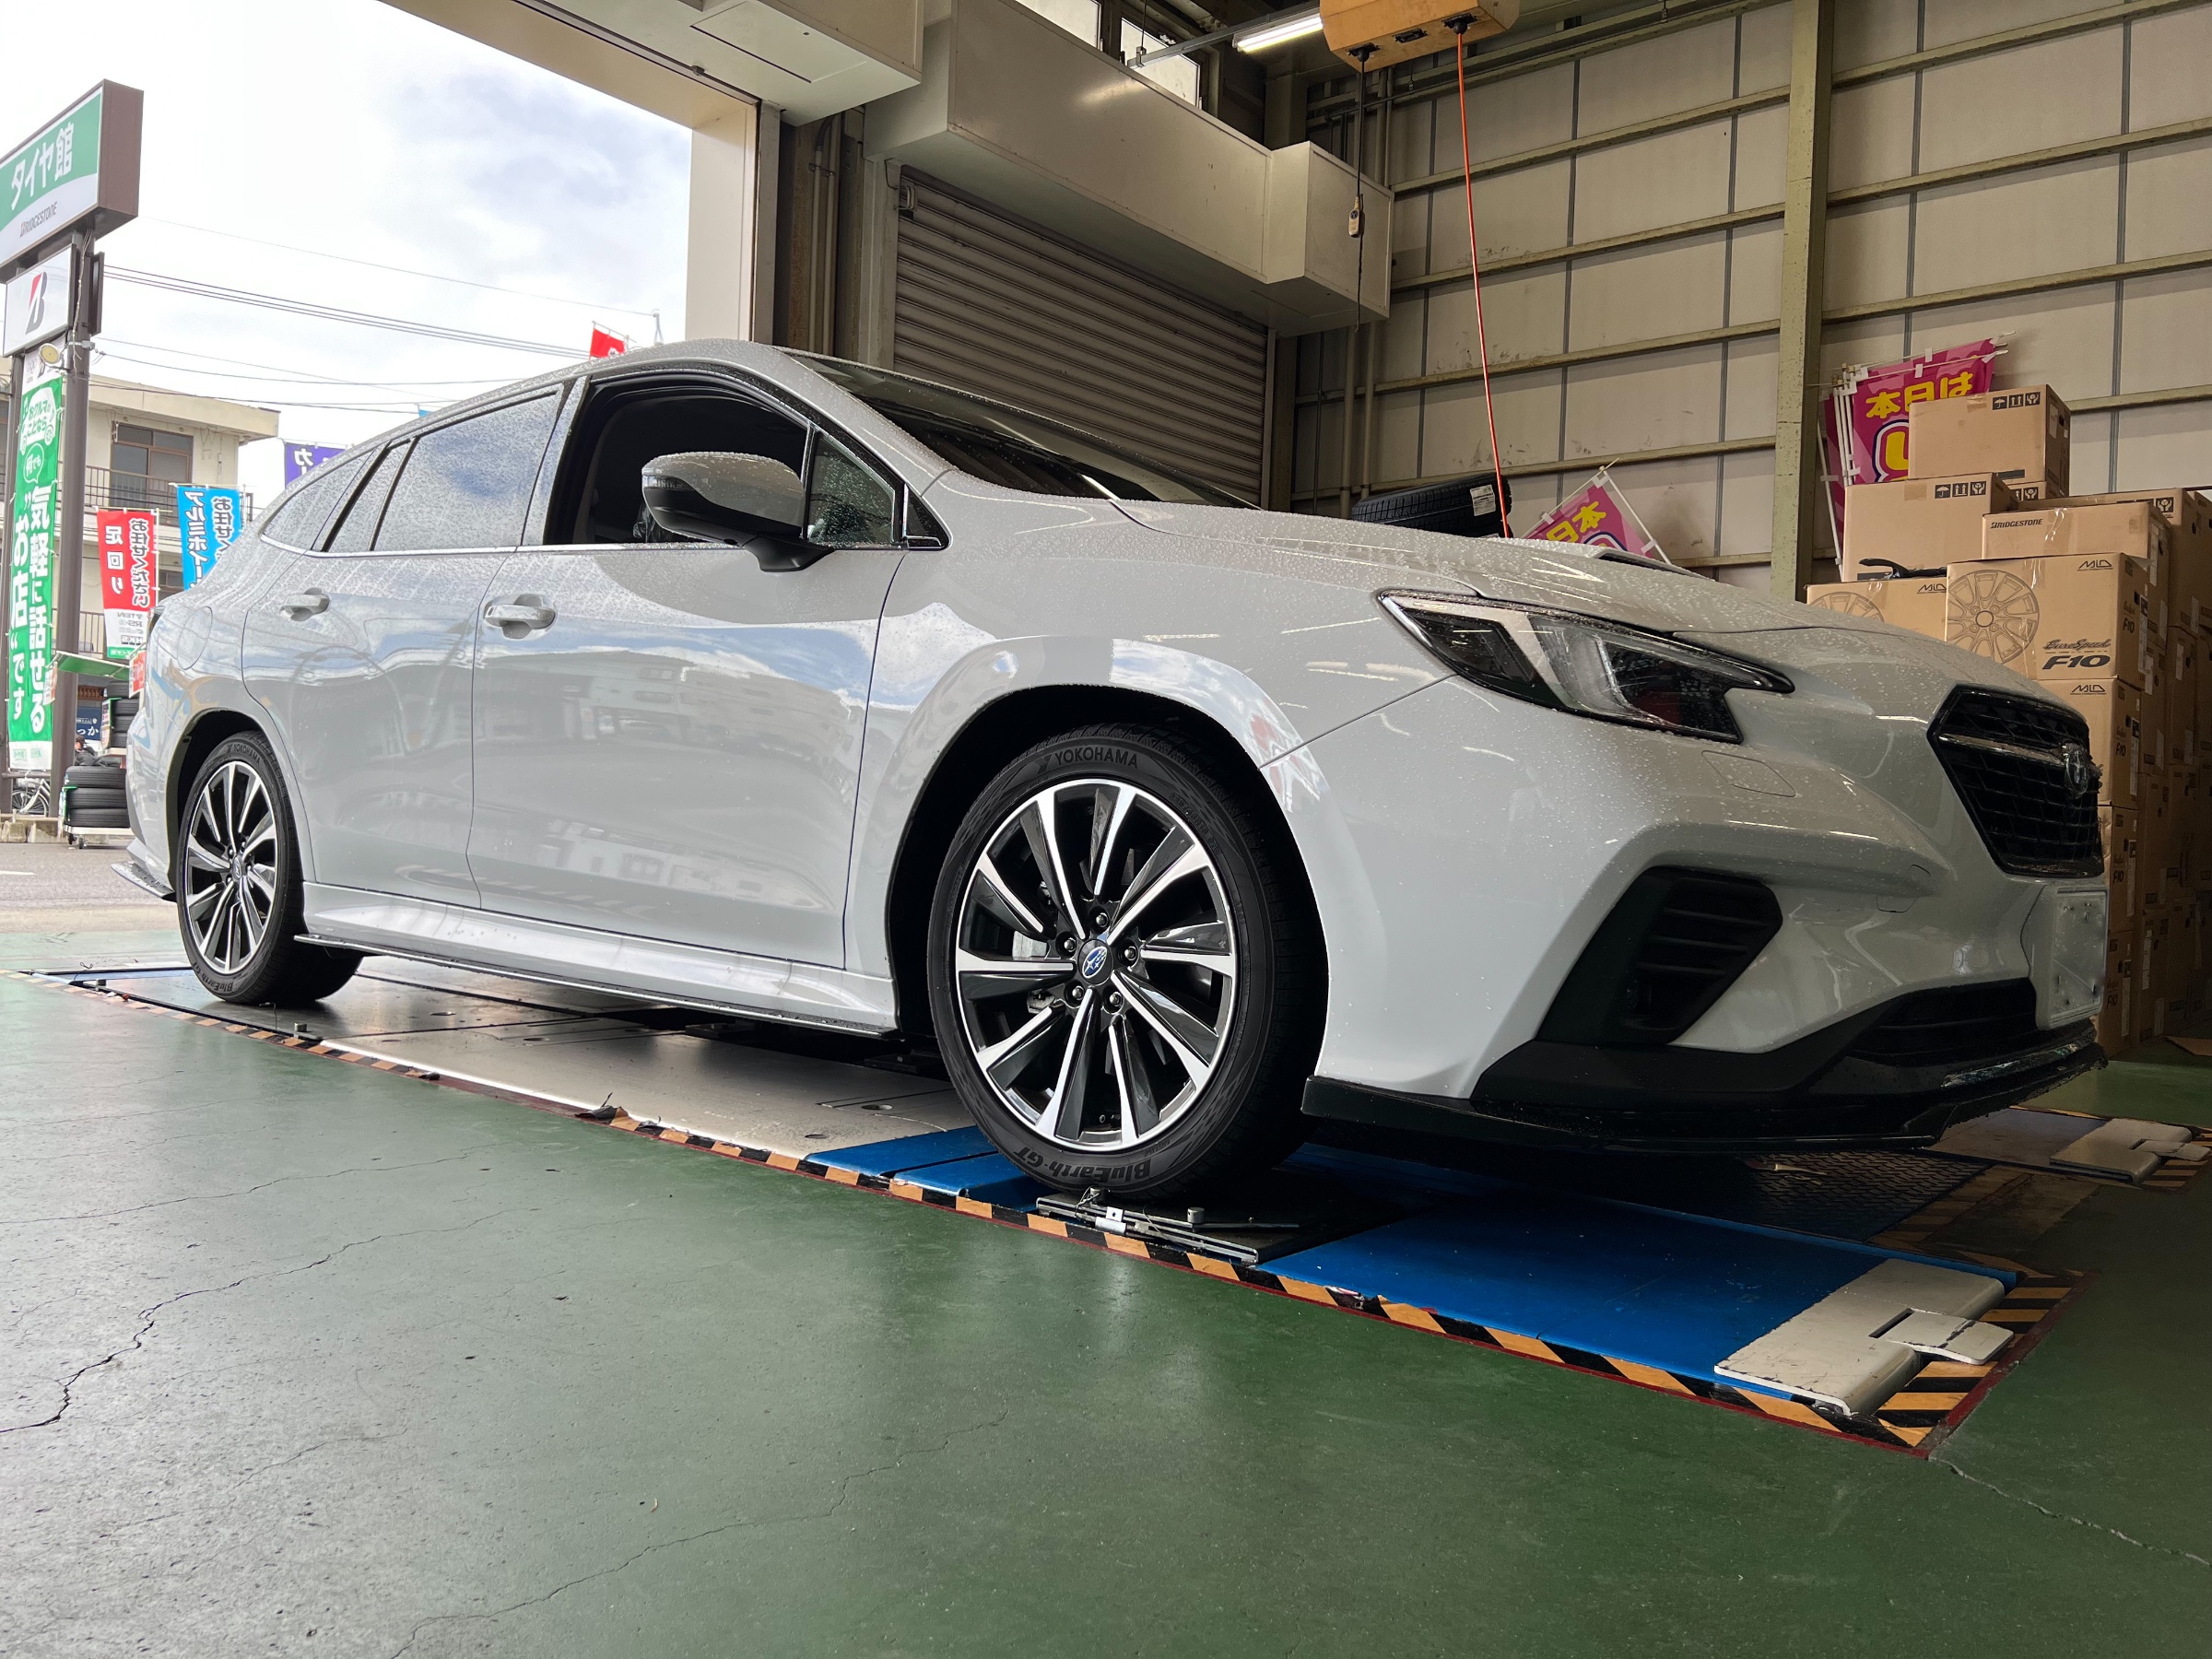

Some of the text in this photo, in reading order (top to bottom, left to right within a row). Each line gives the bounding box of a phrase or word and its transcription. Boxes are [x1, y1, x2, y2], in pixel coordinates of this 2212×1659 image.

[11, 122, 75, 211] タイヤ館
[20, 202, 57, 237] BRIDGESTONE
[1865, 371, 1973, 418] 本日は
[1990, 518, 2043, 529] BRIDGESTONE
[29, 485, 52, 734] 気軽に話せる
[2041, 654, 2111, 670] F10
[233, 743, 261, 765] YOKOHAMA
[1054, 745, 1139, 769] YOKOHAMA
